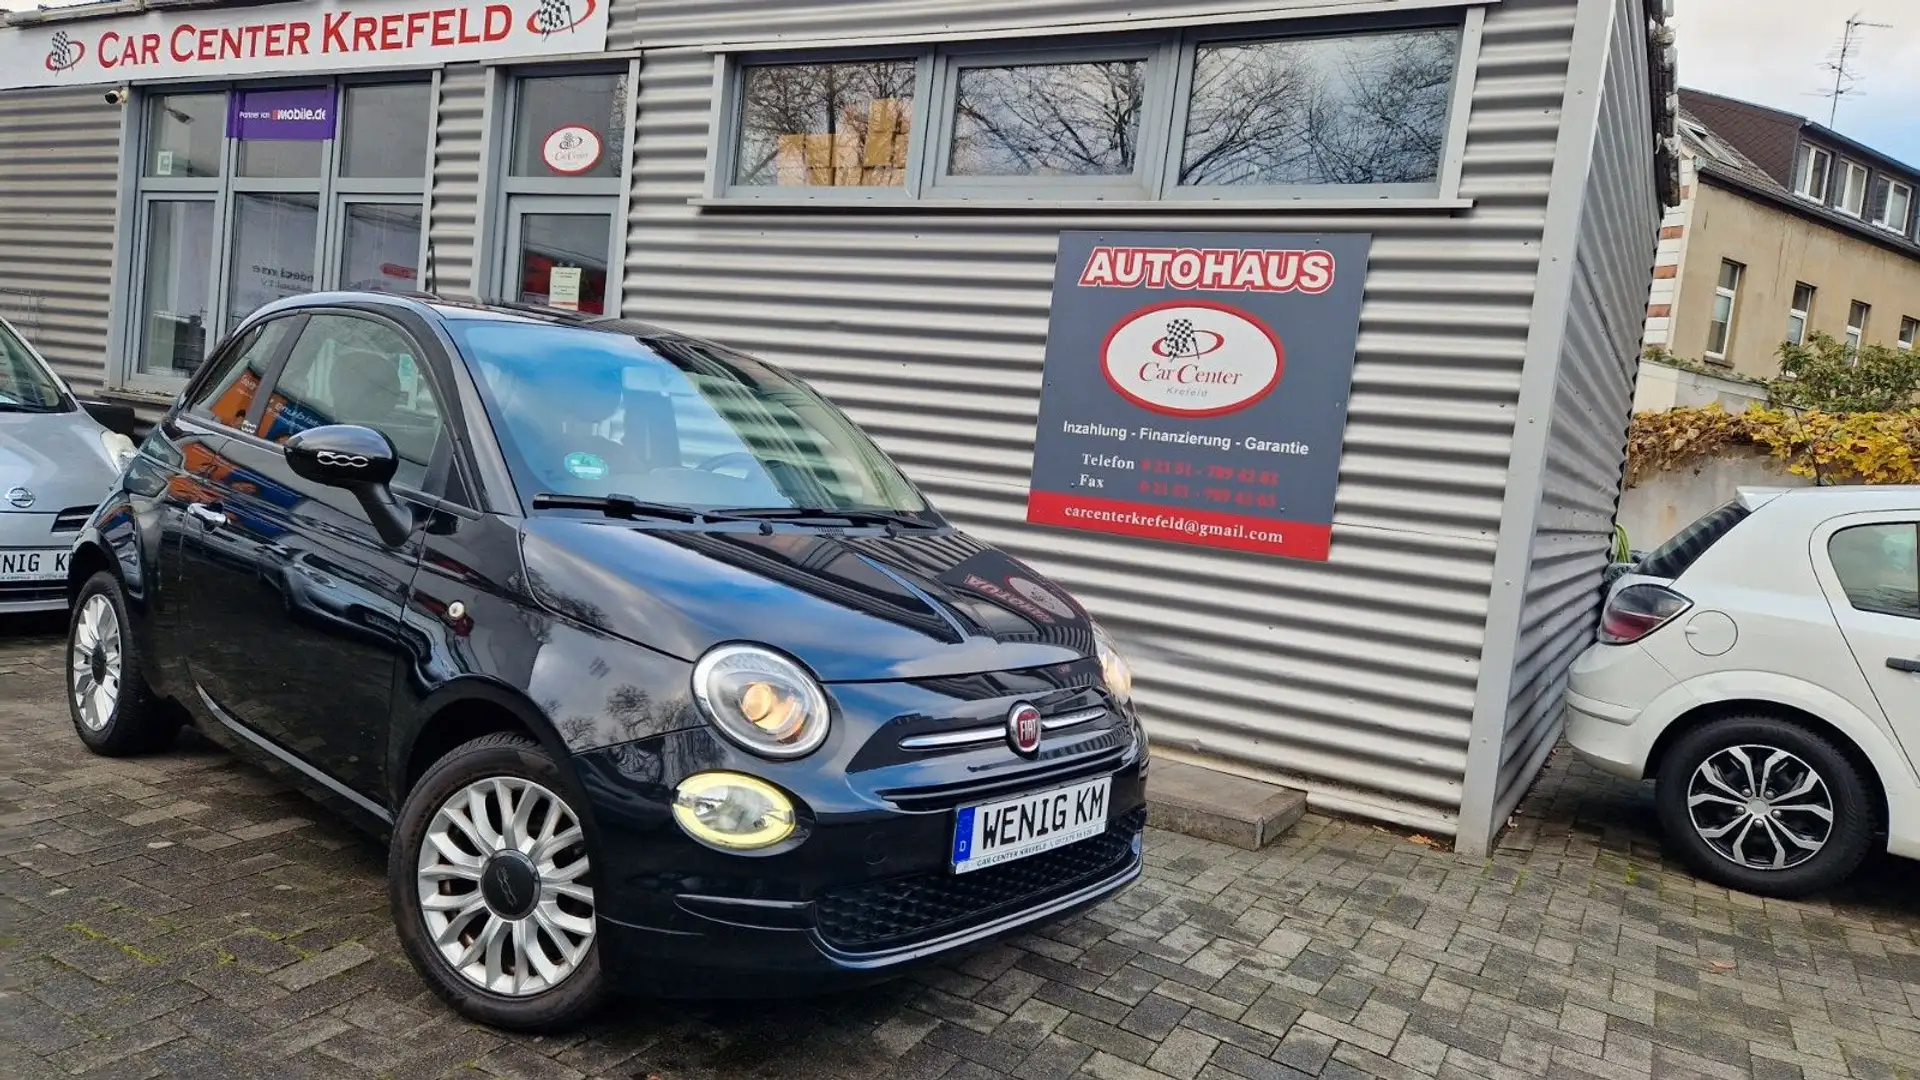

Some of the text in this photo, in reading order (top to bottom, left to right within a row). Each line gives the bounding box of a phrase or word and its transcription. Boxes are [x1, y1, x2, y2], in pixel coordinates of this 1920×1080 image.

[97, 4, 513, 69] CAR CENTER KREFELD
[1079, 247, 1336, 293] AUTOHAUS
[1139, 361, 1243, 385] Car Center
[1166, 386, 1208, 398] Krefeld
[1063, 420, 1127, 440] Inzahlung
[1139, 427, 1231, 450] Finanzierung
[1245, 437, 1309, 455] Garantie
[316, 451, 369, 468] 500
[1082, 453, 1135, 470] Telefon
[1079, 474, 1105, 488] Fax
[1064, 506, 1284, 543] carcenterkrefeld@gmail.com
[0, 553, 40, 573] NIG
[1019, 719, 1036, 741] FIAT
[959, 840, 966, 852] D
[982, 794, 1068, 850] WENIG
[1075, 784, 1105, 825] KM
